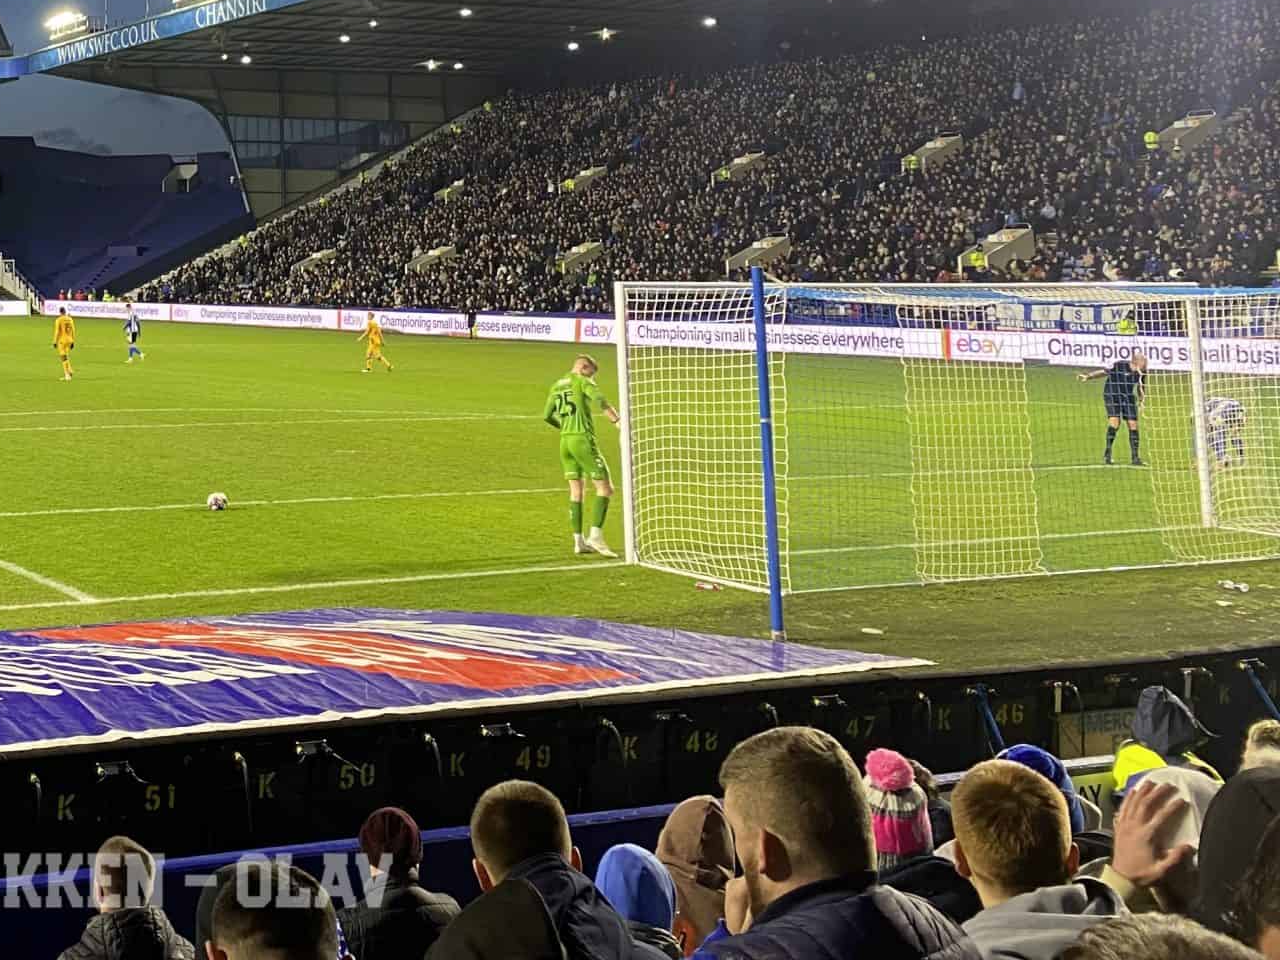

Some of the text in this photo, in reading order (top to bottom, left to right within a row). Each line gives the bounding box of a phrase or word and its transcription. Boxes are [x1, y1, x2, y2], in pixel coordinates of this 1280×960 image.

[56, 20, 160, 64] WWW.SWFC.CO.UK
[342, 312, 365, 332] ebay
[379, 314, 432, 334] Championing
[432, 315, 454, 329] small
[501, 319, 551, 339] everywhere
[584, 318, 614, 339] ebay
[637, 323, 712, 345] Championing
[713, 326, 746, 342] small
[821, 330, 905, 351] everywhere
[956, 333, 1004, 355] ebay
[1047, 337, 1173, 366] Championing
[845, 715, 877, 738] 47
[623, 730, 718, 760] K 48
[450, 746, 551, 777] K 49
[258, 761, 376, 799] K 50
[57, 783, 175, 821] K 51
